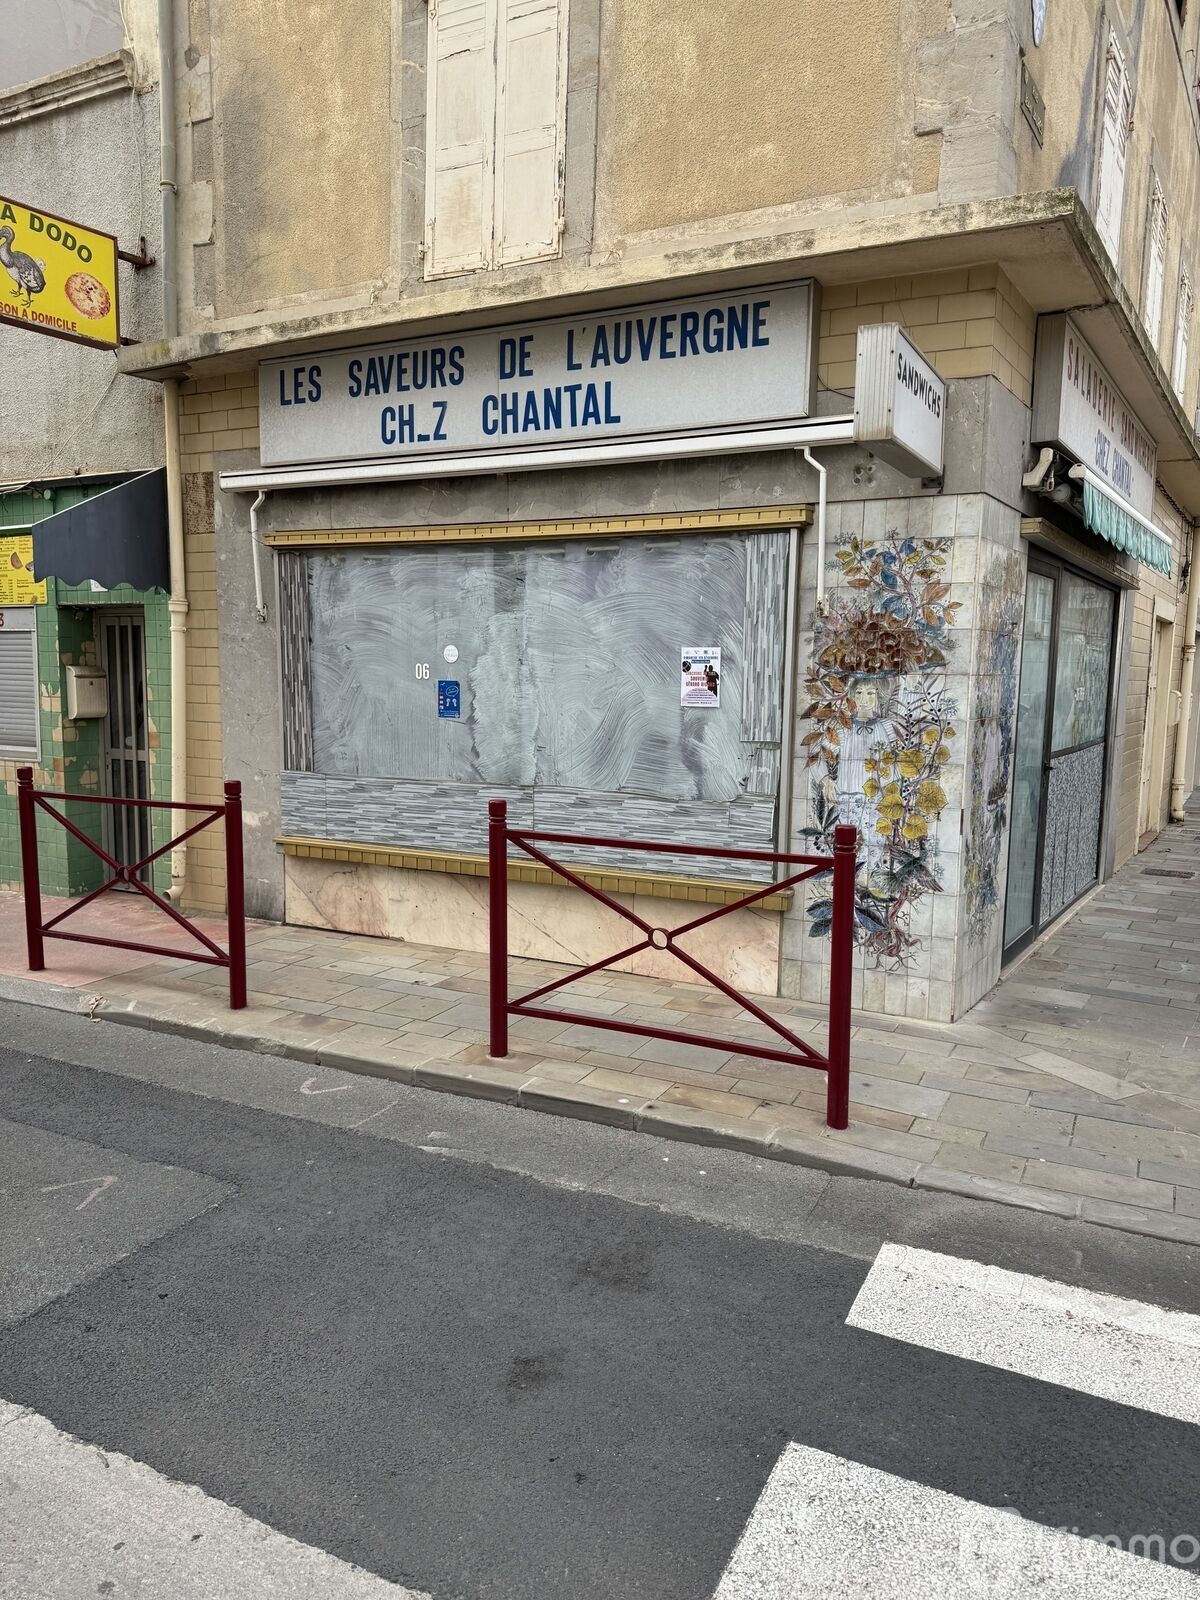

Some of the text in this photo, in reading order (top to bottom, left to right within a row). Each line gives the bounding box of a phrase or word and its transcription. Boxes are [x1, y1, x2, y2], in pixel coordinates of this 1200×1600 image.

[29, 213, 92, 263] DODO
[22, 308, 28, 319] A
[31, 311, 77, 332] DOMICILE
[280, 300, 771, 406] LES SAVEURS DE L'AUVERGNE
[482, 380, 621, 436] CHANTAL
[897, 352, 941, 419] SANDWICHS
[1067, 338, 1116, 433] SALADERIE
[1095, 428, 1111, 477] CHEZ
[415, 663, 430, 680] 06
